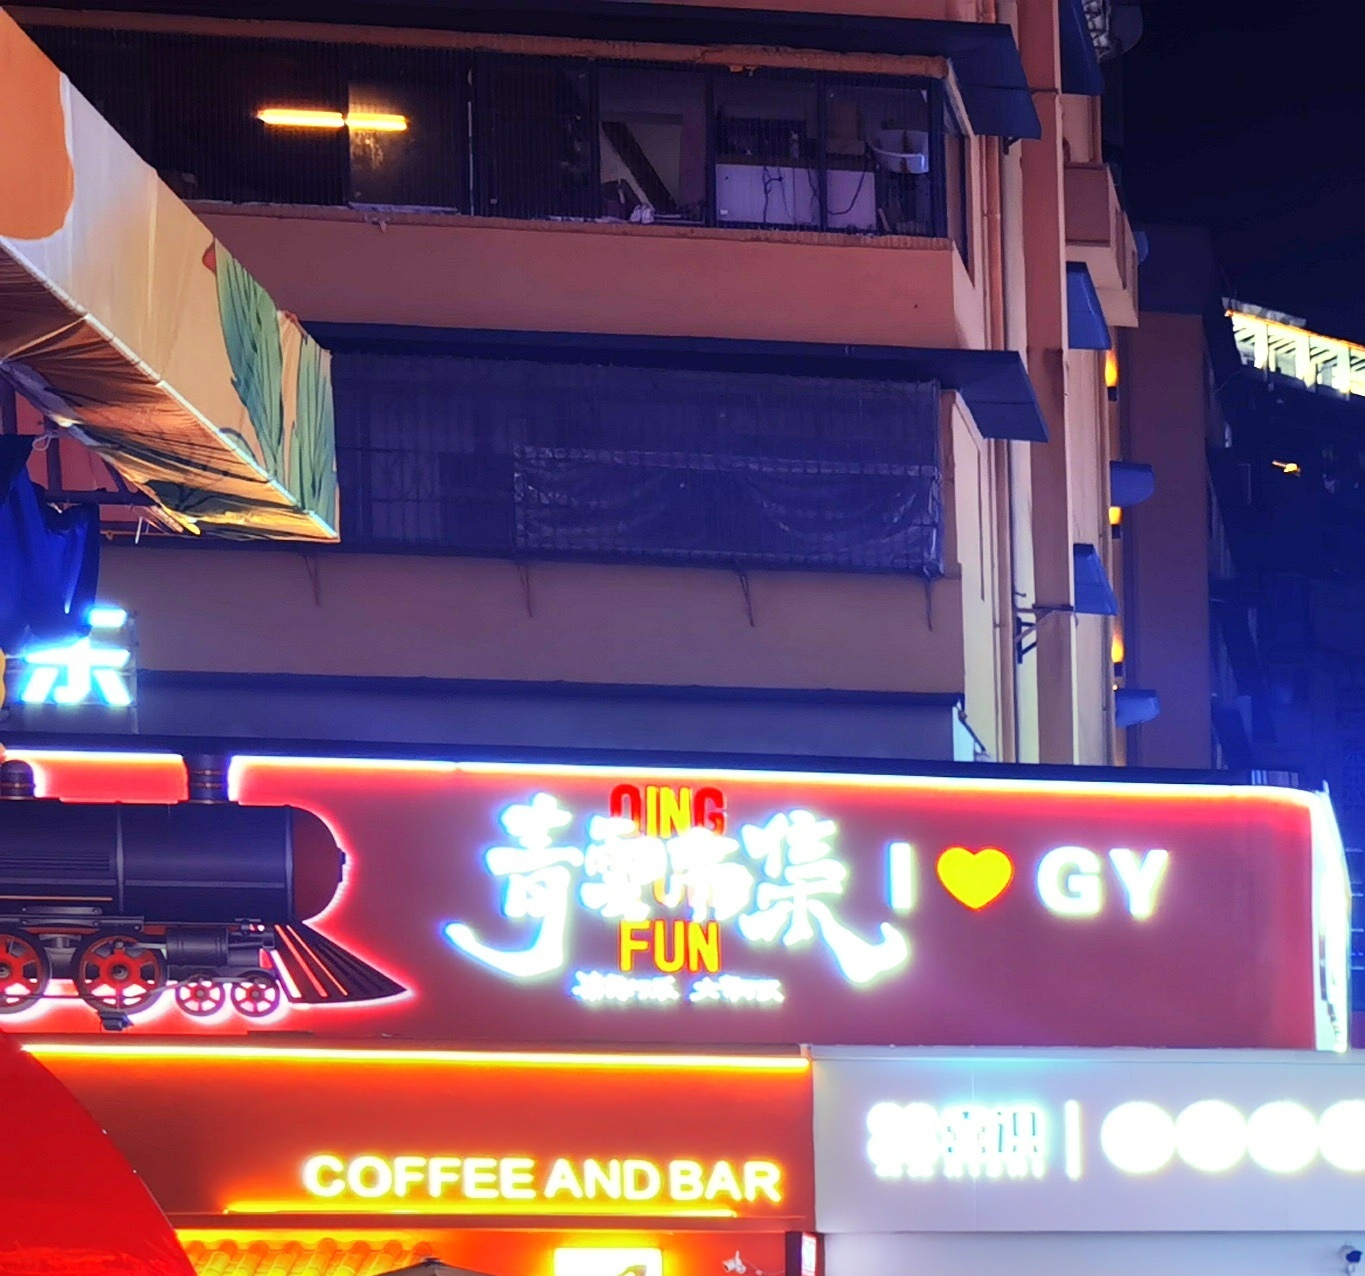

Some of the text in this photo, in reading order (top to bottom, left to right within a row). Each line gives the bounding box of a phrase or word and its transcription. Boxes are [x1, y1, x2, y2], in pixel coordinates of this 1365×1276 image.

[1038, 845, 1169, 919] GY
[619, 919, 720, 973] FUN
[302, 1154, 782, 1204] COFFEE AND BAR
